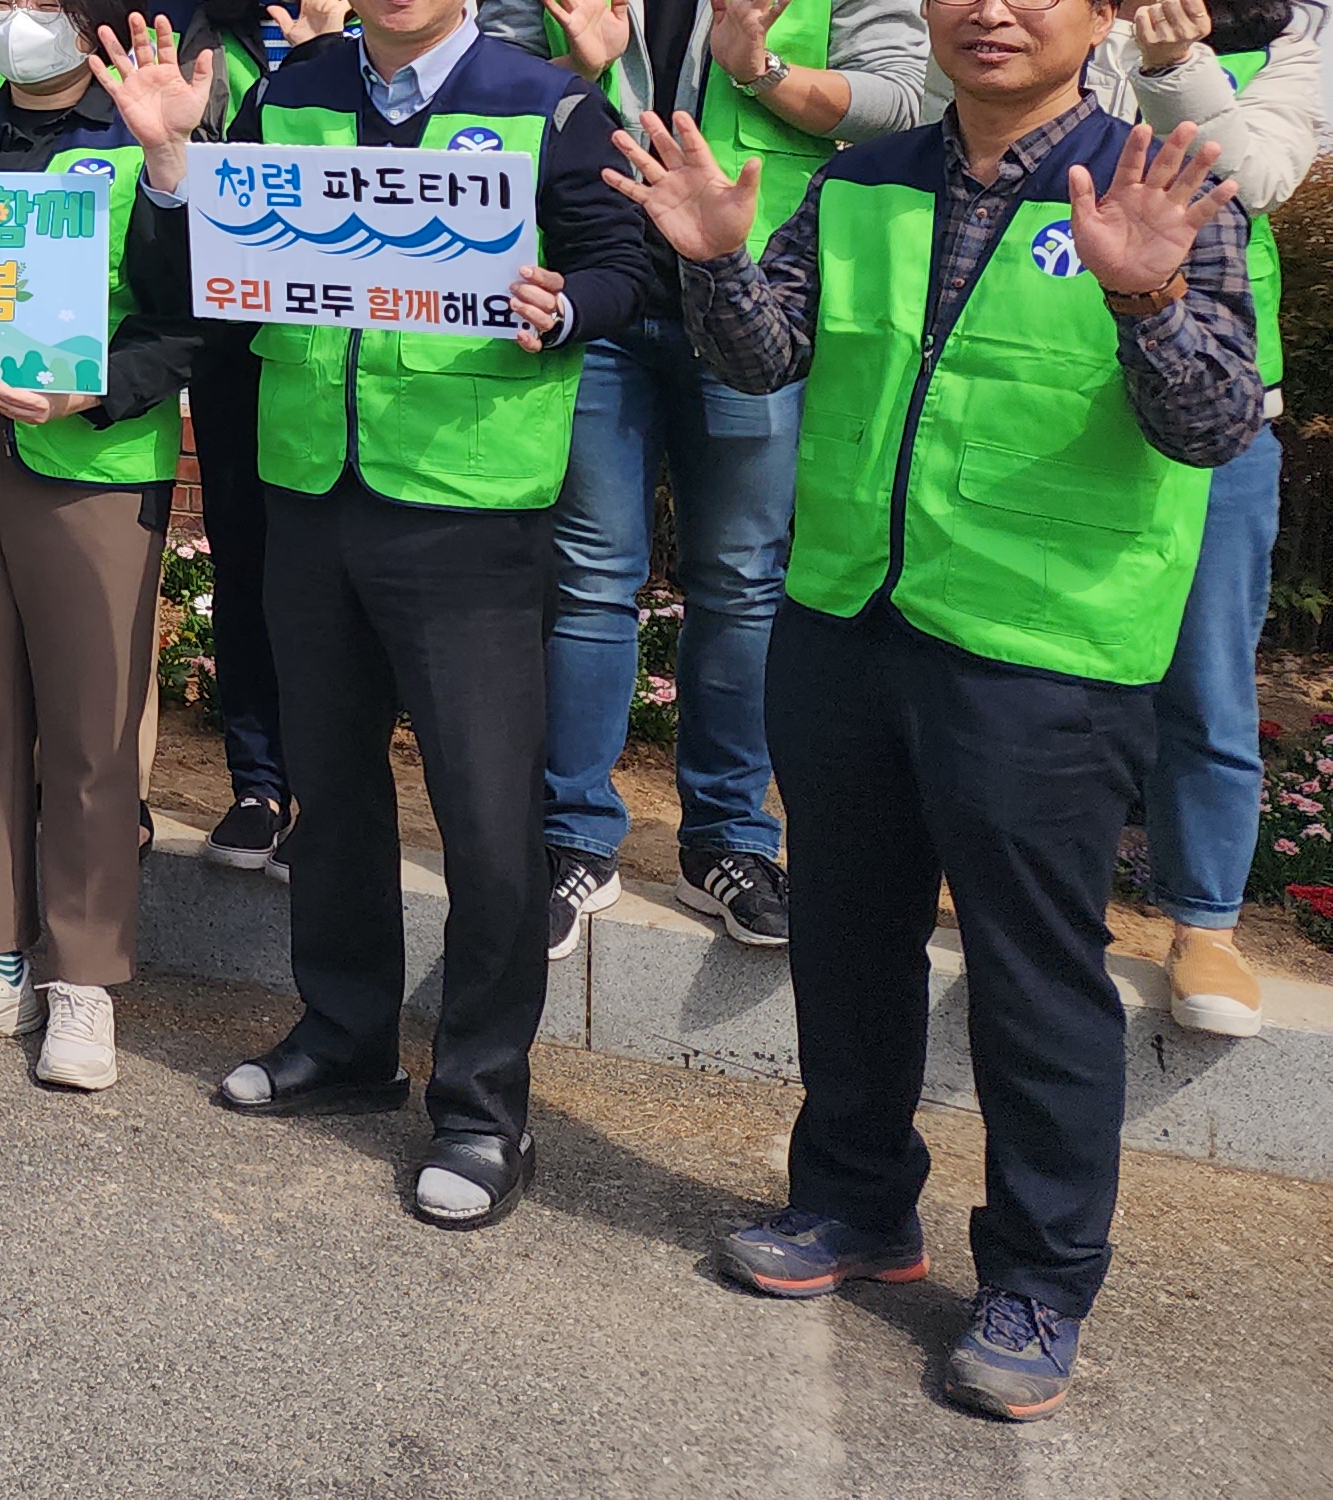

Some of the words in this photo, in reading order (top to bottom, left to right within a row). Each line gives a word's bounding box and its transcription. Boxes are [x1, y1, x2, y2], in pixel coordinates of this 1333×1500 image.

[214, 158, 302, 208] 청렴
[322, 167, 511, 210] 파도타기
[205, 277, 272, 312] 우리
[285, 282, 354, 318] 모두
[366, 285, 531, 331] 함께해요
